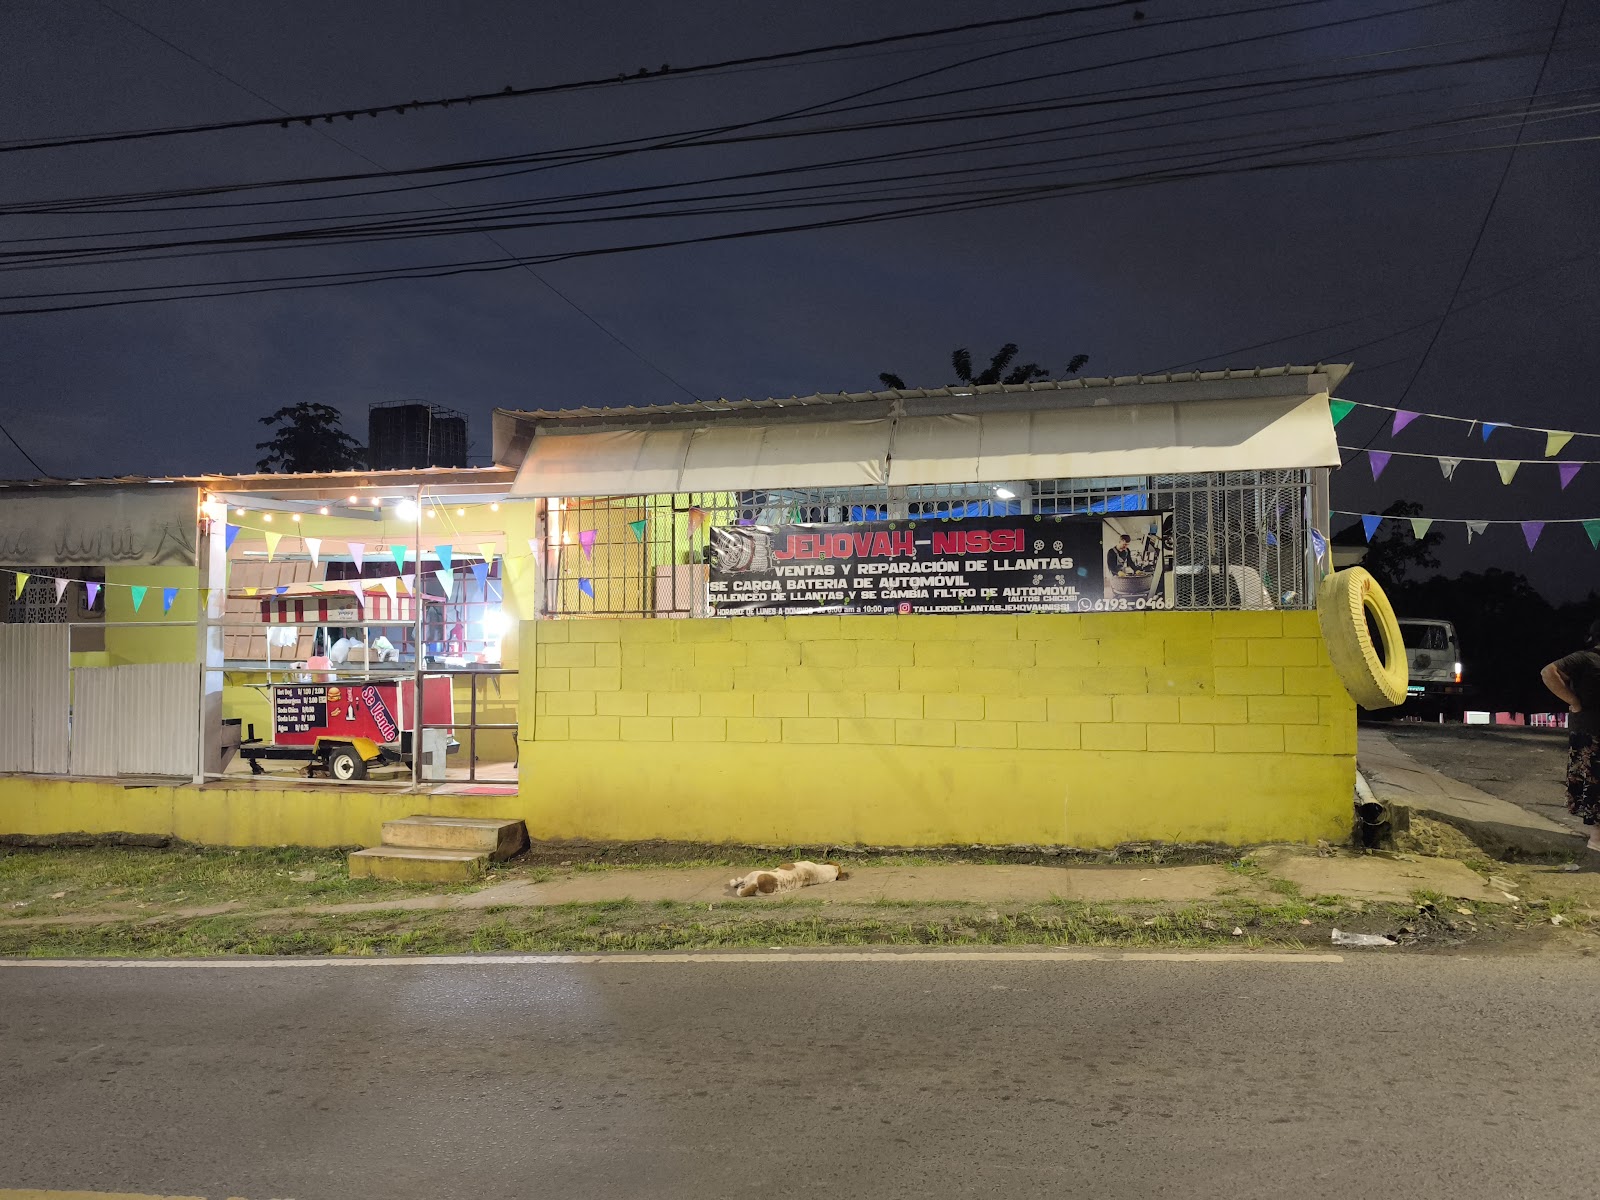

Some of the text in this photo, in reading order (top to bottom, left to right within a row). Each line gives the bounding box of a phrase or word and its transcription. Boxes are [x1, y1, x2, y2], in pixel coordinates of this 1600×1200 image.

[773, 529, 1025, 560] JEHOVAH-NISSI
[775, 557, 1073, 577] VENTAS Y REPARACIÓN DE LLANTAS
[710, 573, 969, 591] SE CARGA BATERIA DE AUTOMÓVIL
[709, 584, 1080, 602] BALENCEO DE LLANTAS Y SE CAMBIA FILTRO DE AUTOMÓVIL
[756, 607, 777, 615] LUNES
[863, 605, 882, 613] 10:00
[884, 605, 895, 615] pm
[361, 685, 396, 742] Se Vende
